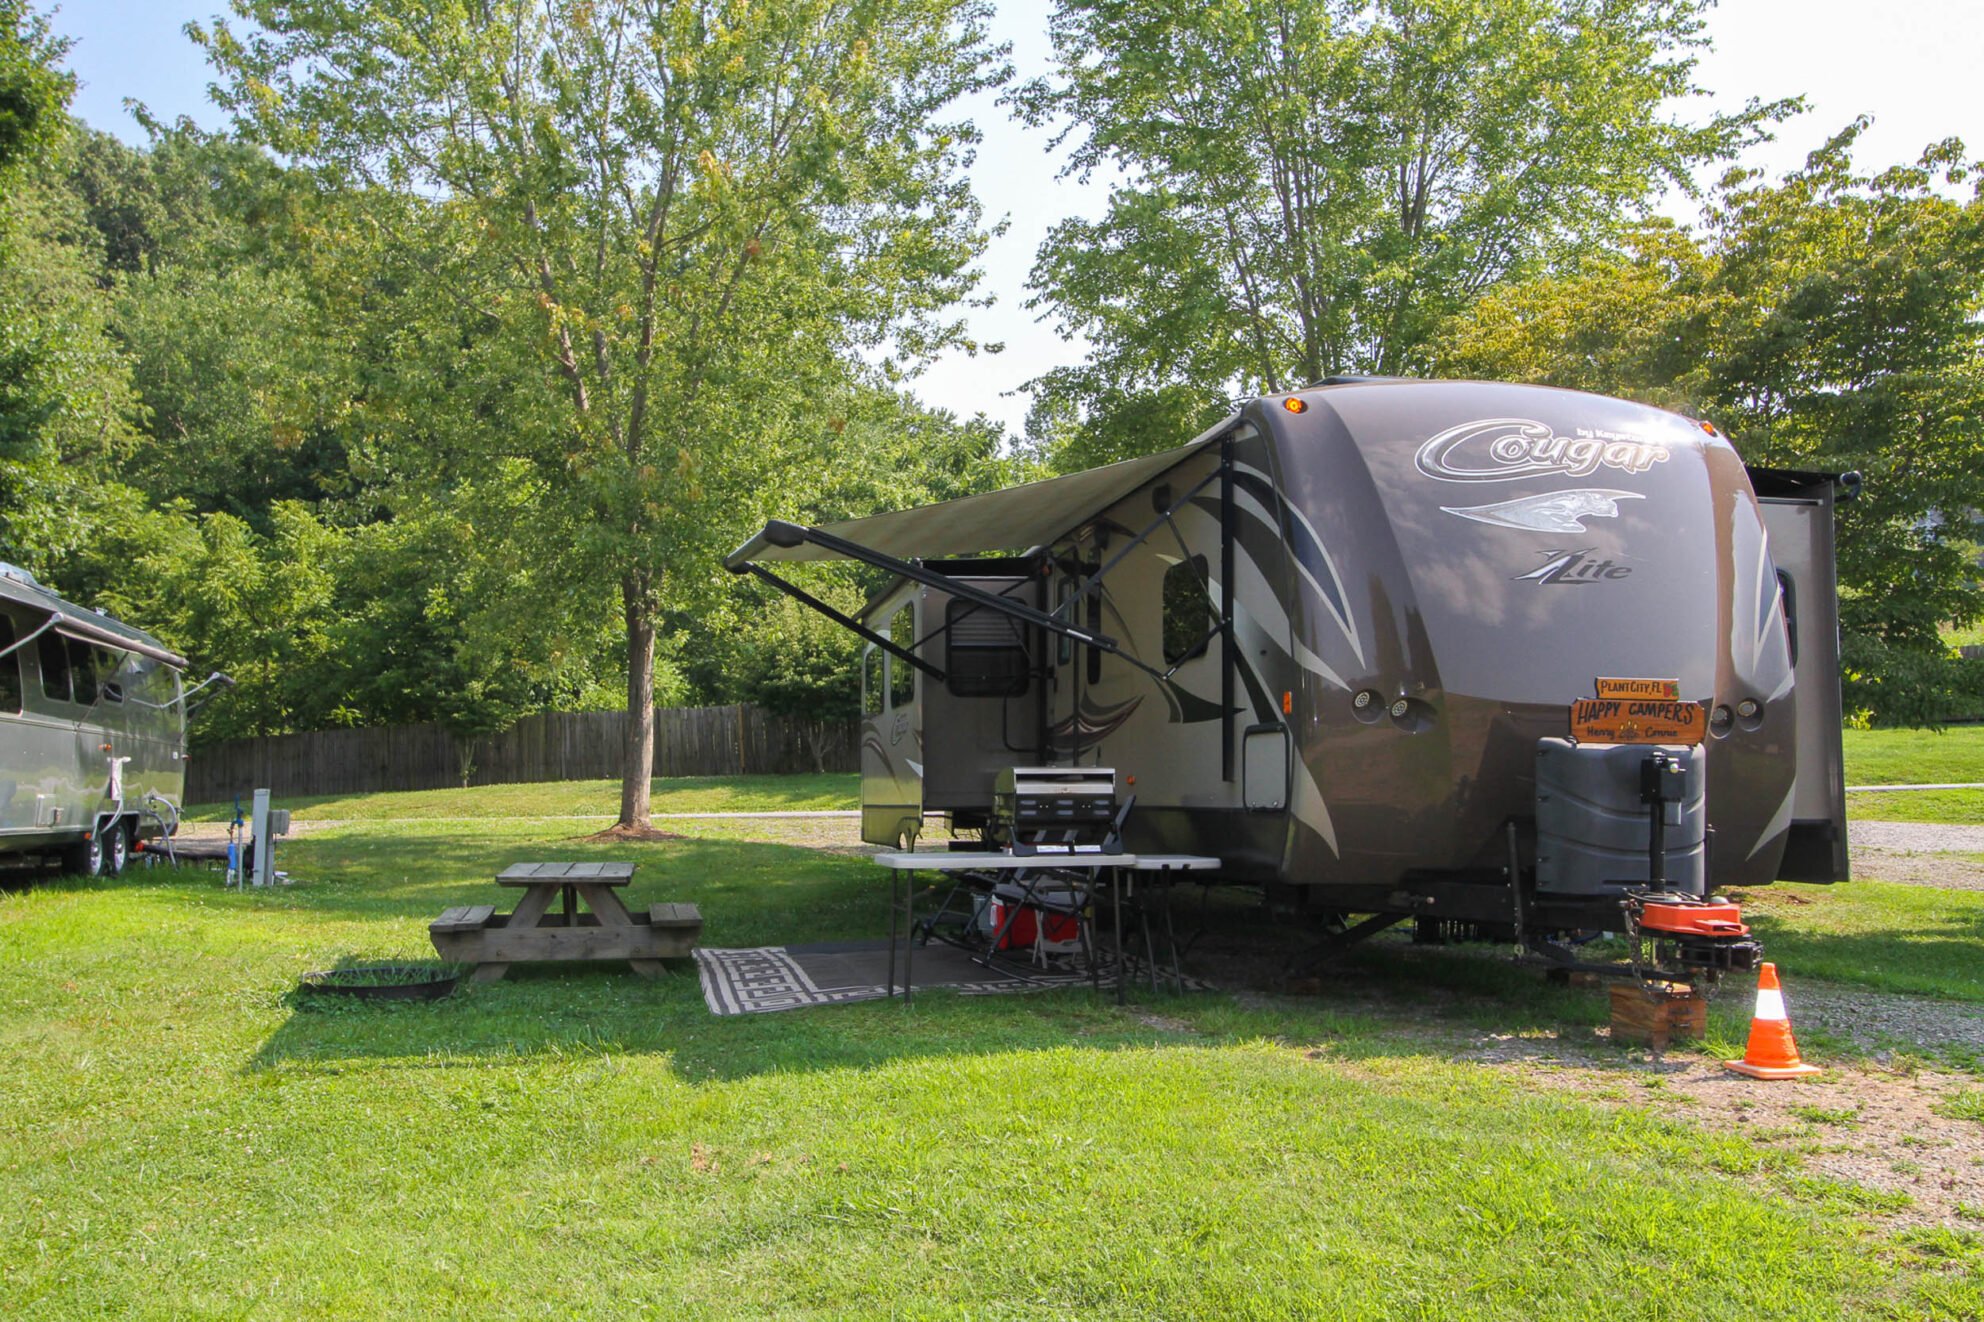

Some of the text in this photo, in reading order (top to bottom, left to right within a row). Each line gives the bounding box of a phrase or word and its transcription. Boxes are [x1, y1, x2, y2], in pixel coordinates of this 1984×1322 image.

[1576, 427, 1594, 439] by
[1414, 418, 1670, 483] Cougar
[1577, 702, 1695, 726] HAPPY CAMPERS
